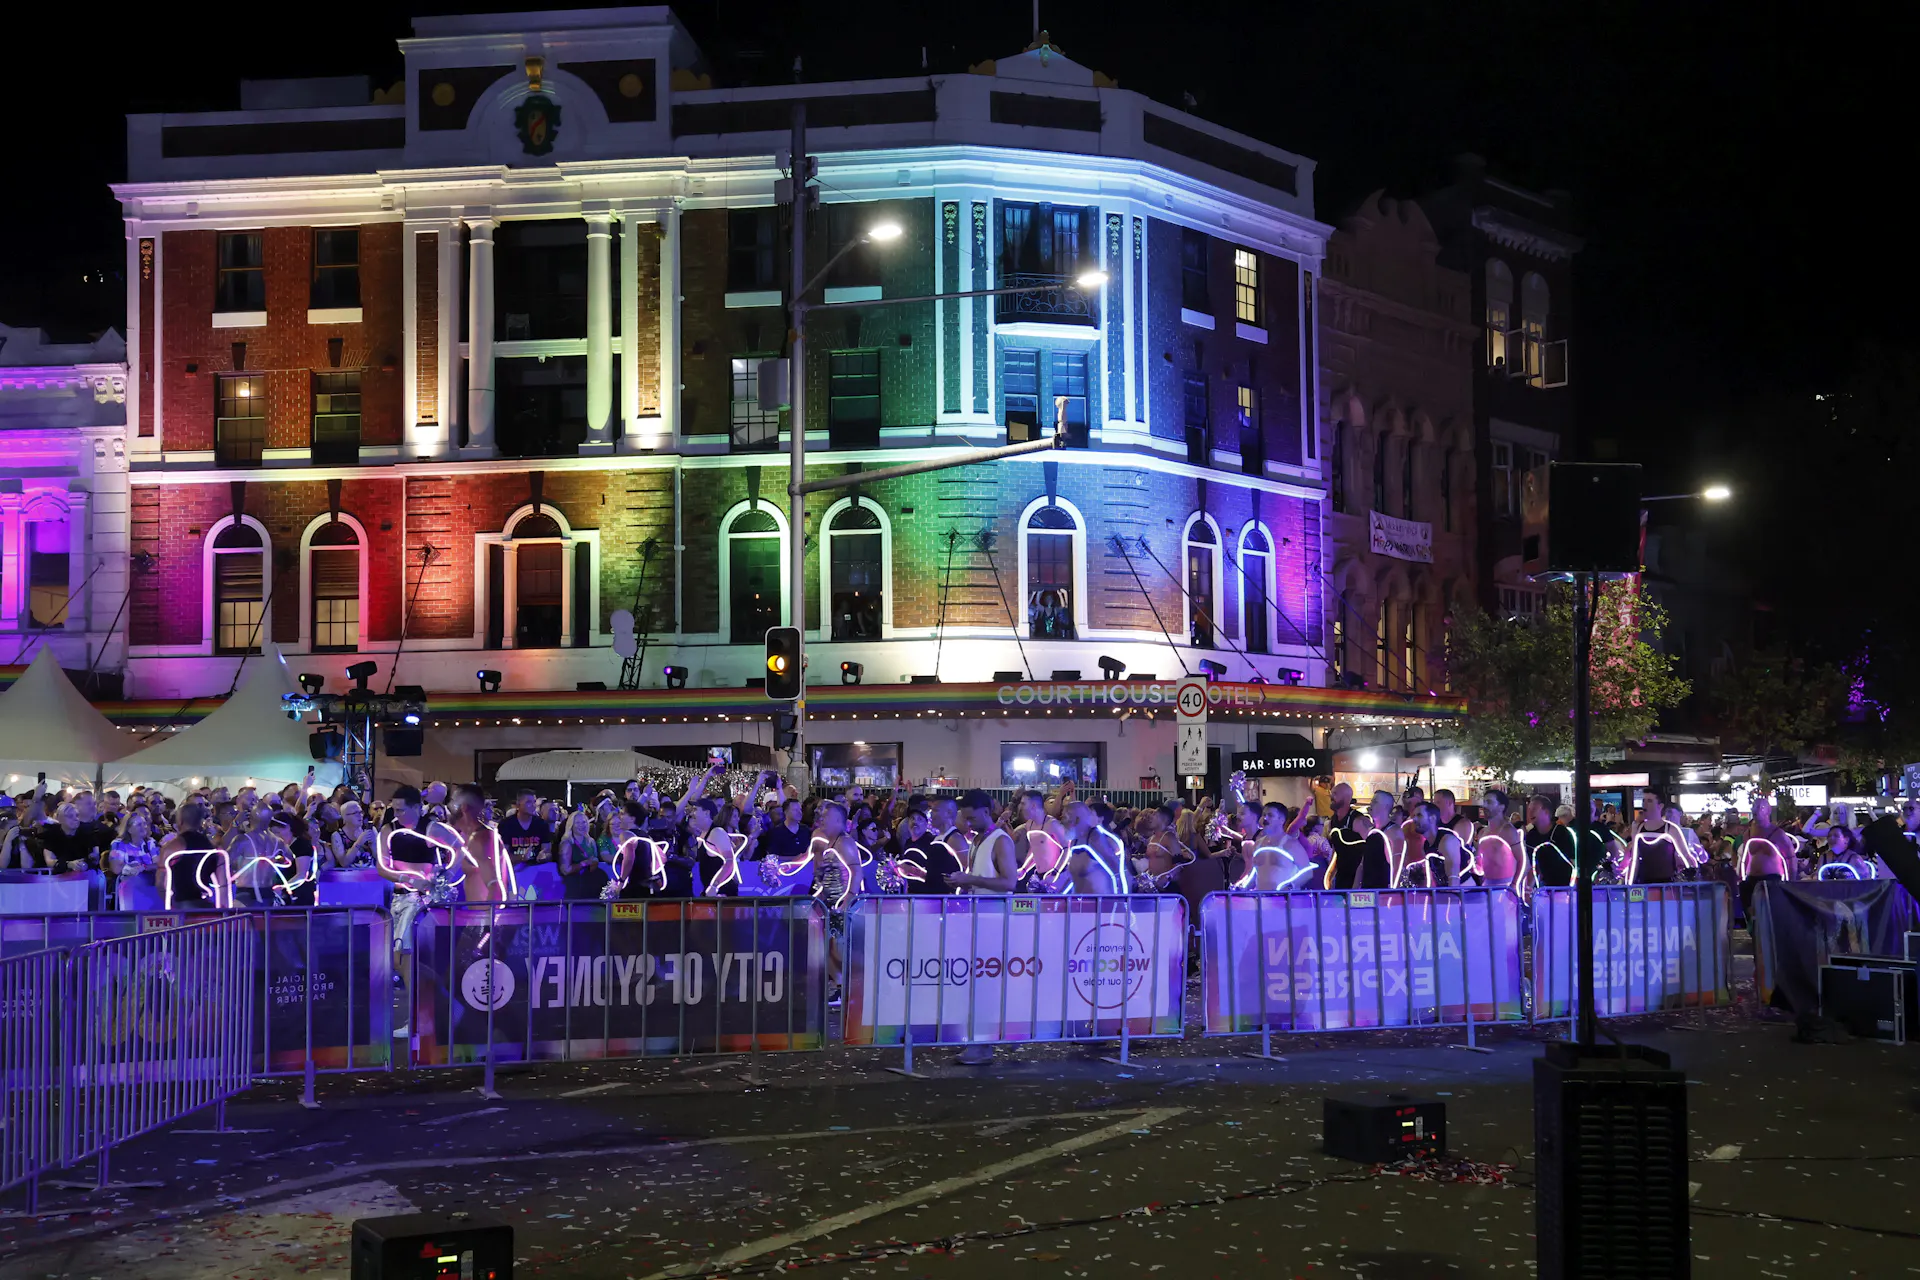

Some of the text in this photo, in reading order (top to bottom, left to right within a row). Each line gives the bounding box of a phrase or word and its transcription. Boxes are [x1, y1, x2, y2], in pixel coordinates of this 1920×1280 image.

[997, 684, 1254, 705] COURTHOUSE OTEL
[1182, 693, 1202, 708] 40
[1242, 757, 1316, 770] BAR BISTRO
[1352, 893, 1371, 902] TFH
[616, 904, 640, 913] TFH
[1014, 900, 1033, 908] TFH
[147, 917, 173, 927] TFH
